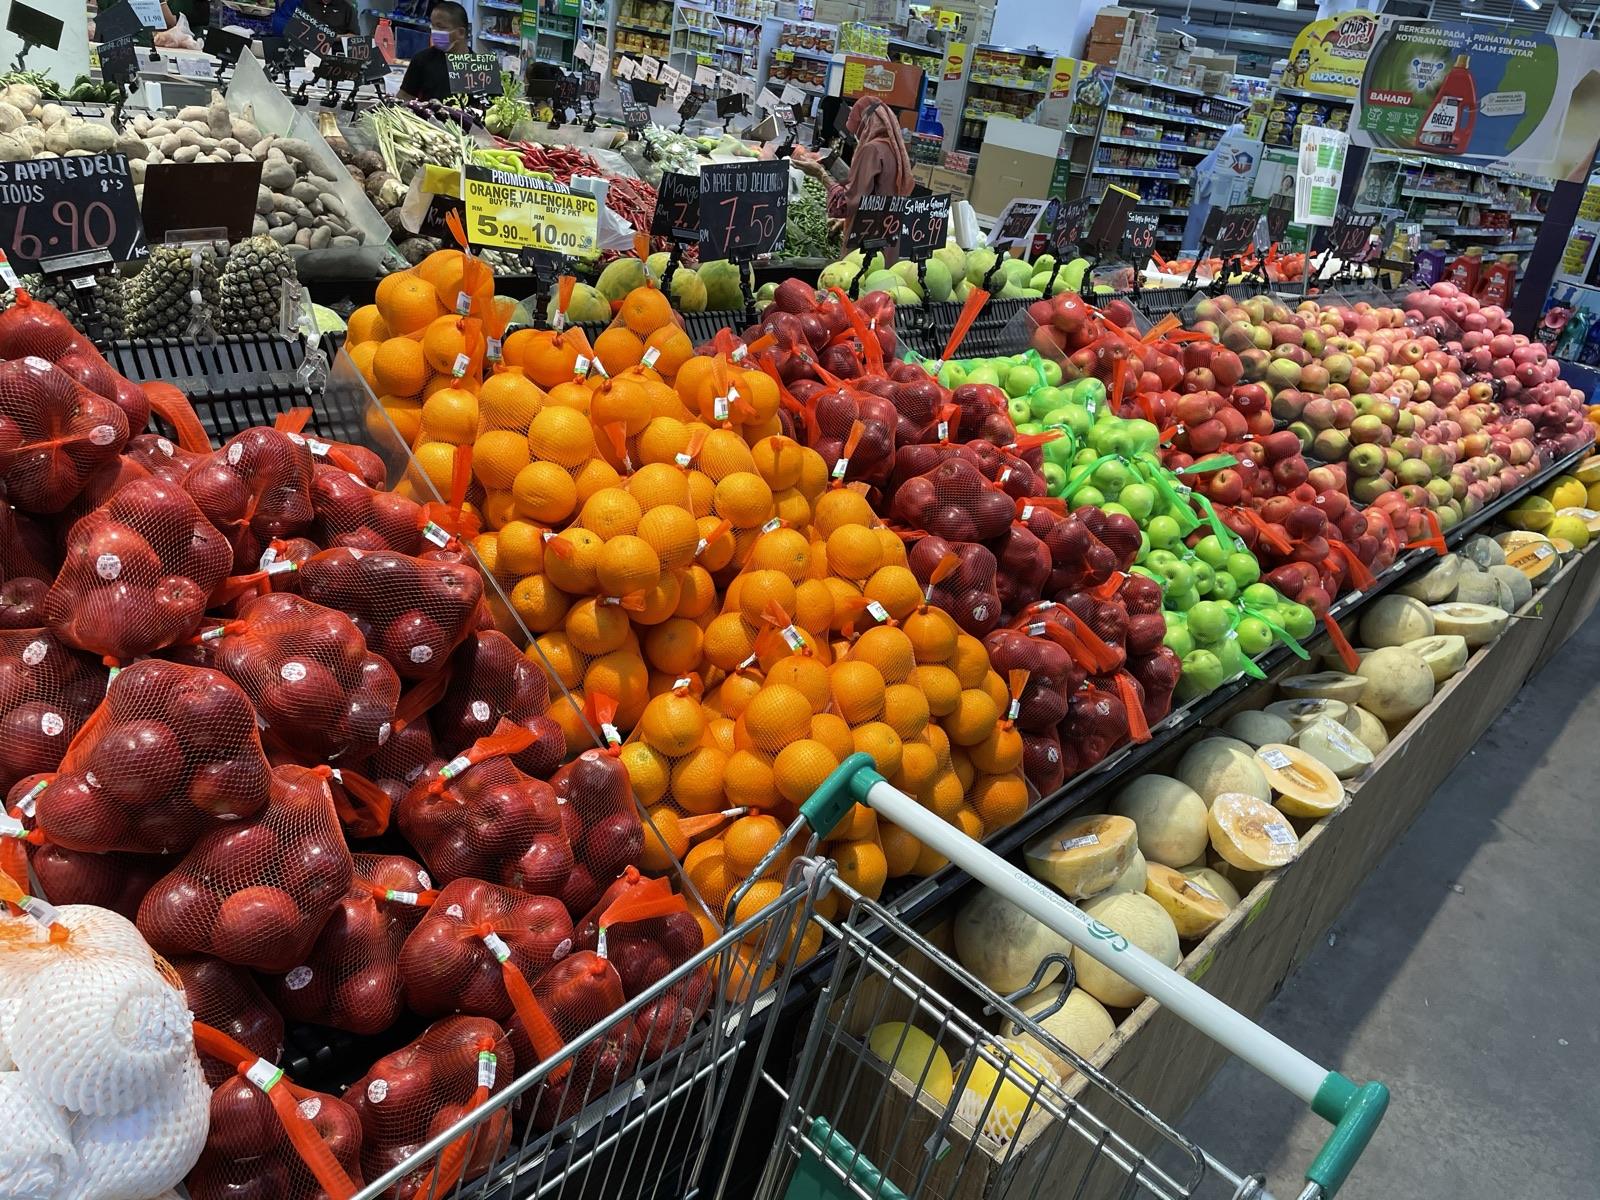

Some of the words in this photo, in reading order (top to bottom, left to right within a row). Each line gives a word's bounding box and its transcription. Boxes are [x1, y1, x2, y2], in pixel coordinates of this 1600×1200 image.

[1340, 20, 1367, 35] Chips
[1398, 24, 1441, 37] BERKESAN
[1443, 30, 1466, 39] PADA
[1395, 33, 1436, 45] KOTORAN
[1473, 34, 1511, 45] PRIHATIN
[1513, 40, 1537, 48] PADA
[447, 52, 496, 63] CHARLESTON
[1471, 44, 1496, 53] ALAM
[1497, 48, 1533, 58] SEKITAR
[452, 62, 468, 71] HOT
[470, 63, 493, 72] CHILI
[464, 72, 491, 89] 11.90
[1369, 91, 1411, 105] BAHARU
[629, 111, 647, 122] 4.20
[1431, 113, 1455, 127] BREEZE
[78, 154, 128, 177] DELI
[492, 169, 545, 191] PROMOTION
[553, 182, 570, 194] DAY
[663, 174, 699, 204] Mango
[712, 172, 733, 193] APPLE
[735, 172, 747, 193] RED
[470, 183, 516, 201] ORANGE
[520, 190, 574, 210] VALENCIA
[576, 201, 595, 213] 8PC
[489, 198, 503, 206] BUY
[510, 201, 522, 209] PKT
[859, 195, 887, 211] JAMBU
[546, 206, 559, 214] BUY
[568, 209, 581, 217] PKT
[12, 200, 117, 260] 6.90
[477, 215, 517, 240] 5.90
[699, 229, 709, 242] RM
[719, 196, 774, 254] 7.50
[858, 215, 900, 242] 7.90
[911, 218, 942, 246] 6.99
[1223, 217, 1256, 242] 2.50
[532, 223, 576, 248] 10.00
[1133, 227, 1153, 248] 6.90
